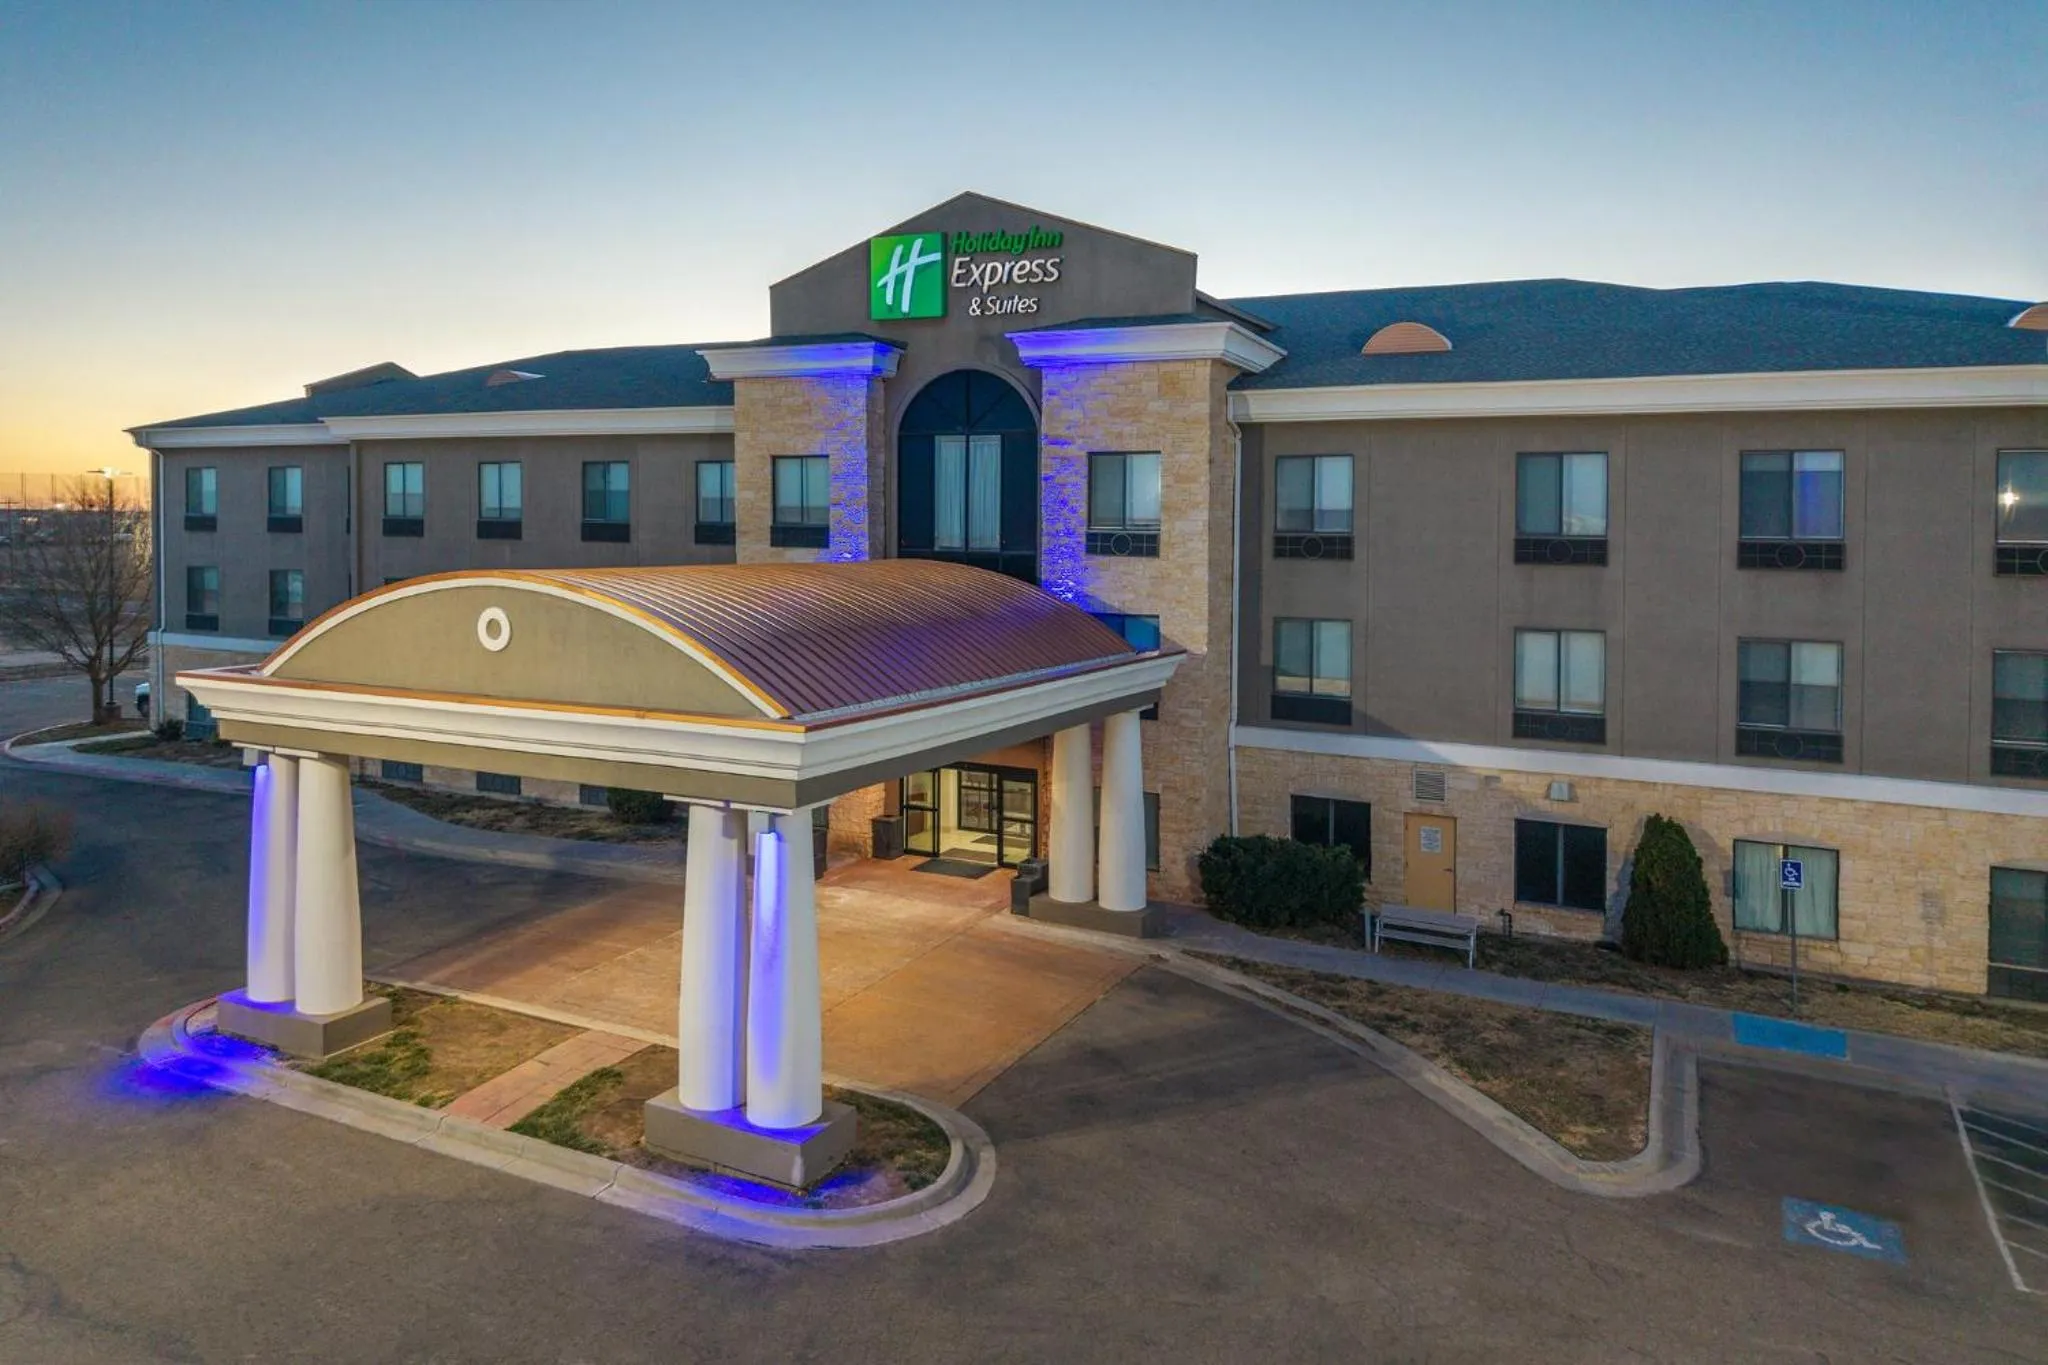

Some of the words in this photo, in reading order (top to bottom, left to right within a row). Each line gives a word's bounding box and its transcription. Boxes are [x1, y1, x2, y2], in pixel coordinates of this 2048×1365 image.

[951, 229, 1025, 255] Holiday
[1027, 224, 1063, 249] Inn
[877, 238, 941, 313] H
[951, 256, 1061, 294] Express
[969, 297, 982, 316] &
[985, 295, 1038, 315] Suites
